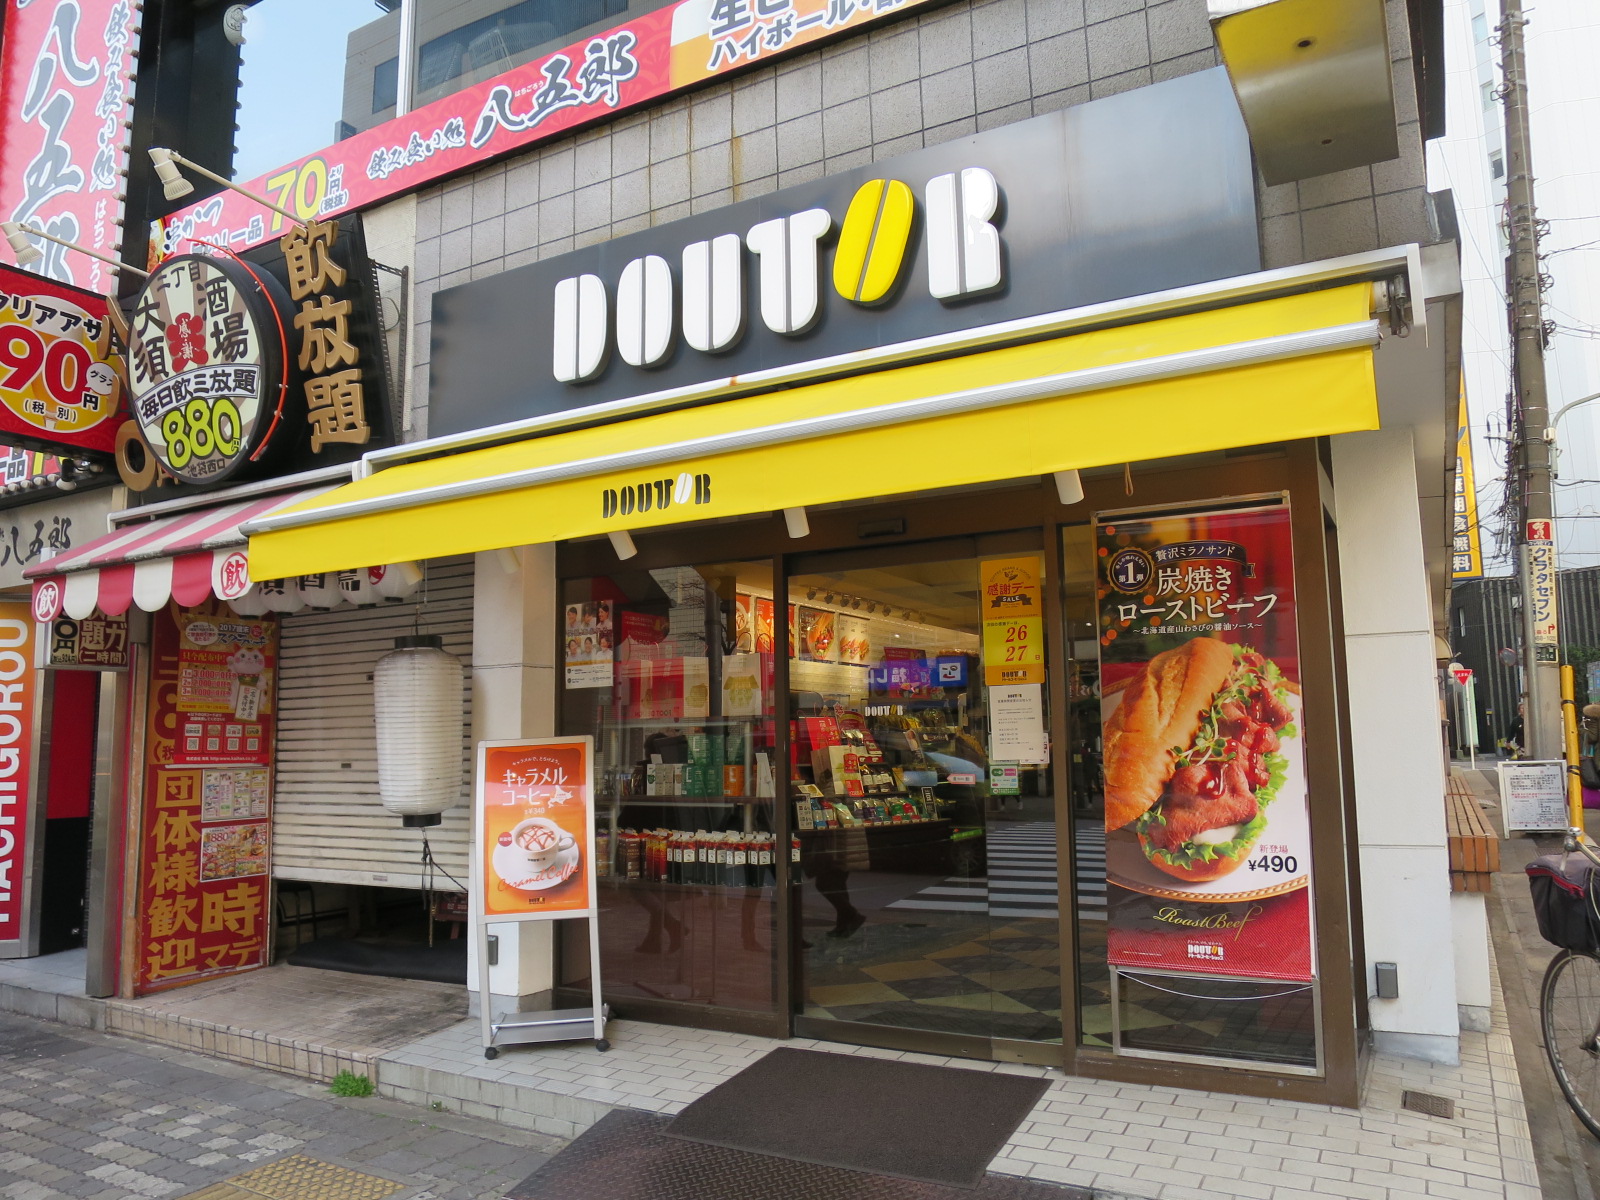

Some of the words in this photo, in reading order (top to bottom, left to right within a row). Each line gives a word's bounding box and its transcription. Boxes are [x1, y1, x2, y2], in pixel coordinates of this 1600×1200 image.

[470, 30, 638, 148] 八五郎
[553, 167, 1002, 383] DOUTOR
[196, 276, 249, 363] 酒場
[280, 220, 371, 453] 飲放題
[602, 472, 711, 518] DOUTOR
[1155, 545, 1236, 562] 贅沢ミラノサンド
[223, 559, 247, 590] 飲
[987, 582, 1035, 596] 感謝デー
[1156, 565, 1232, 596] 炭焼き
[1535, 547, 1550, 622] クラタセブン
[36, 587, 57, 617] 飲
[1118, 593, 1278, 622] ローストビーフ
[1005, 625, 1028, 642] 26
[1005, 645, 1028, 662] 27
[864, 704, 904, 716] DOUTOR
[502, 767, 568, 788] キャラメル
[502, 788, 550, 806] コーヒー
[1248, 855, 1298, 873] ¥490
[1259, 845, 1289, 854] 新登場
[147, 769, 202, 981] 団体様歓迎
[1153, 907, 1208, 928] Roast
[1205, 906, 1263, 941] Beef
[1188, 944, 1224, 956] DOUTOR
